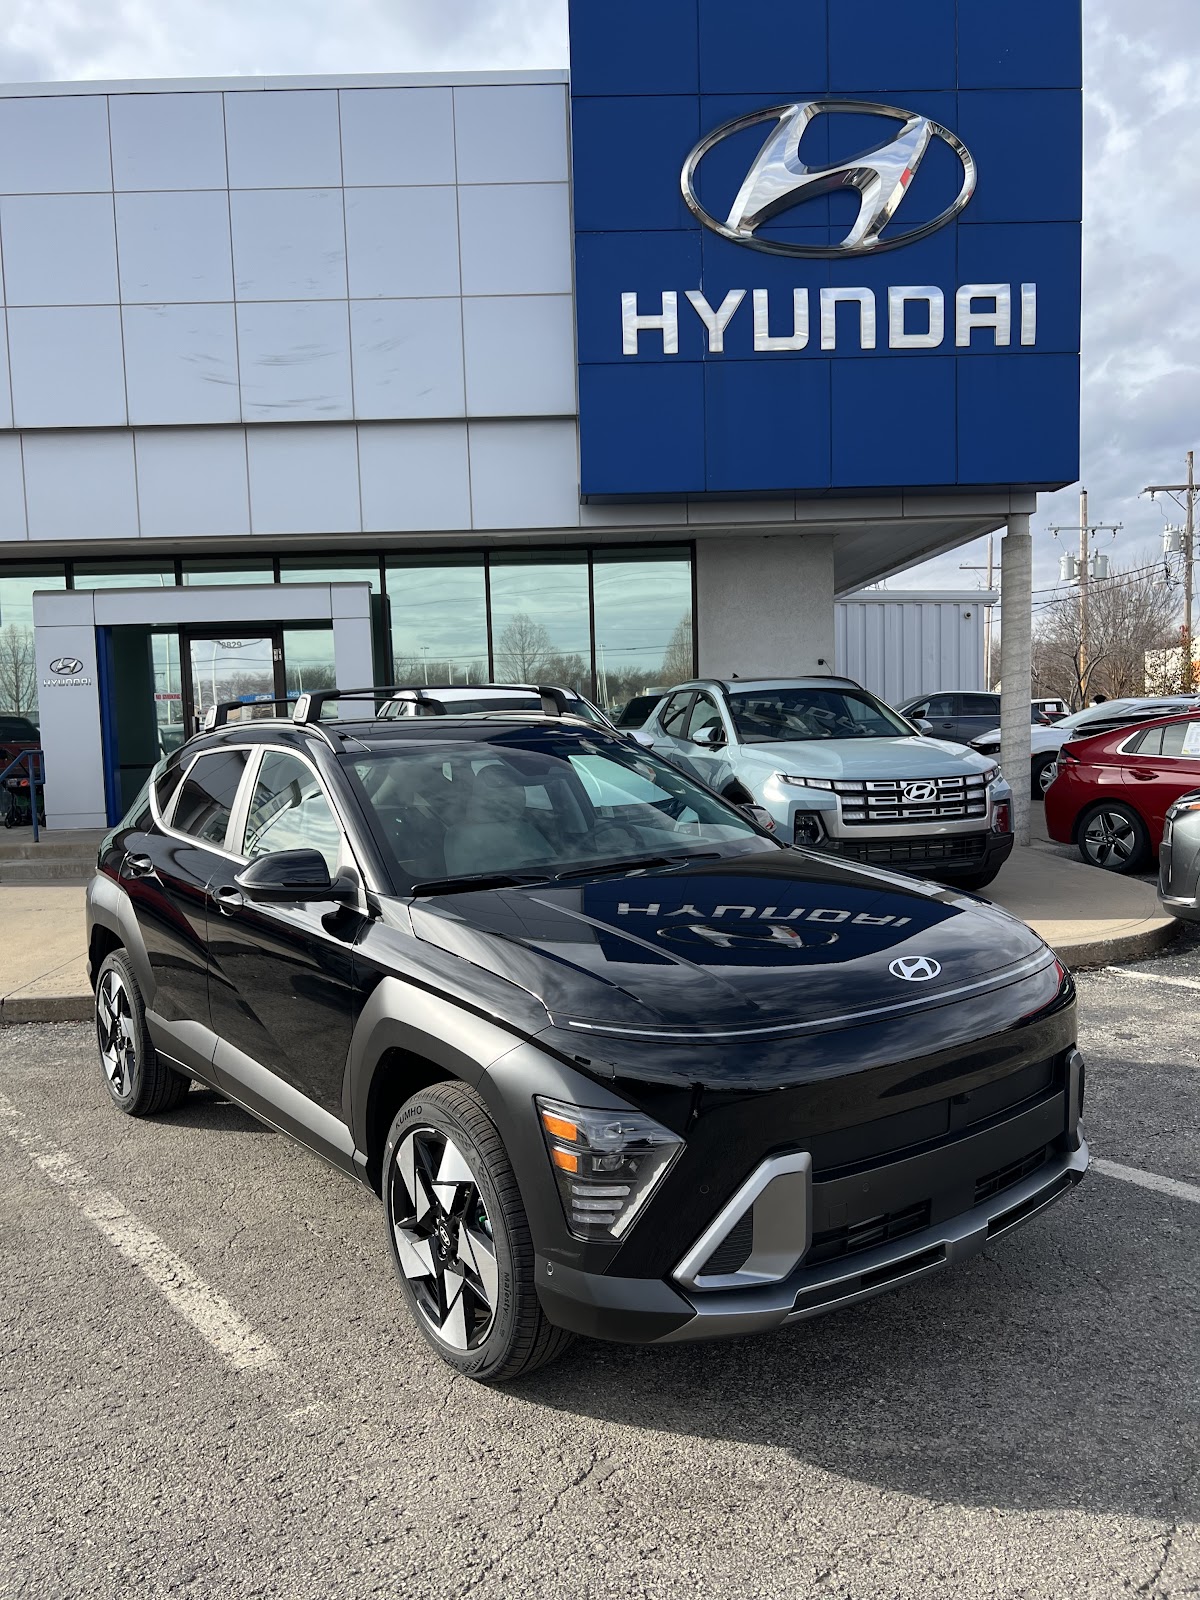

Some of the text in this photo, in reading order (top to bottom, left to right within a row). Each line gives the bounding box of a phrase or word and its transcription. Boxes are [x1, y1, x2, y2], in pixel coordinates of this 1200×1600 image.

[620, 283, 1037, 356] HYUNDAI
[43, 677, 92, 687] HYUNDAI
[395, 1105, 423, 1129] KUMHO
